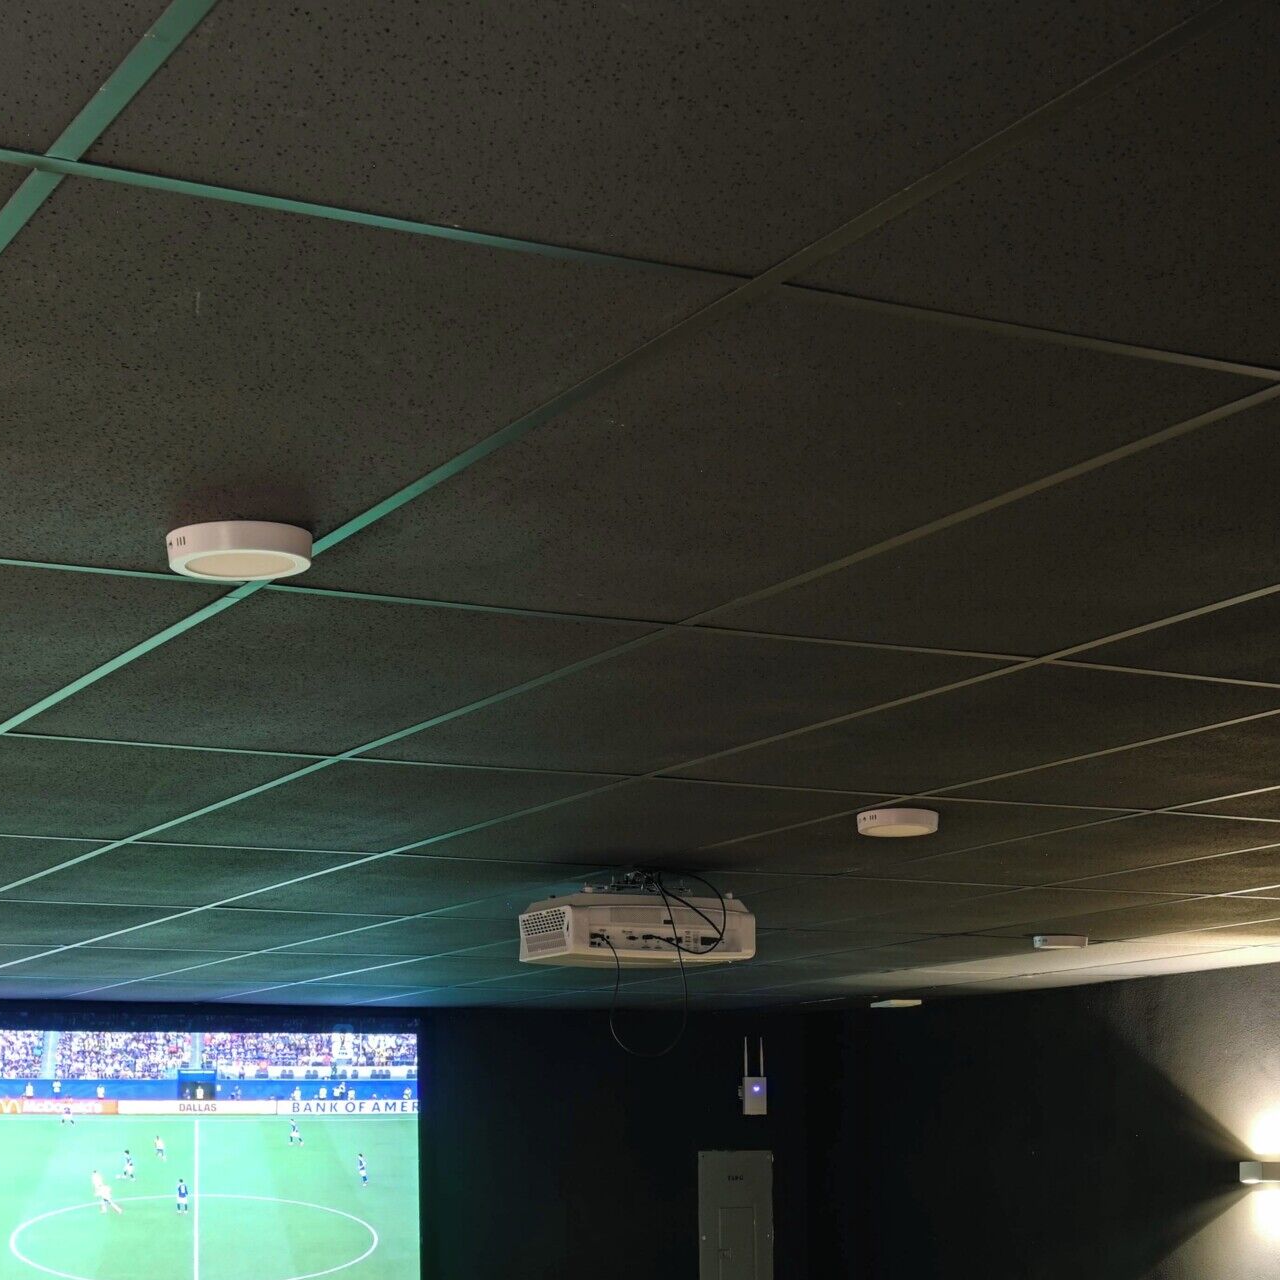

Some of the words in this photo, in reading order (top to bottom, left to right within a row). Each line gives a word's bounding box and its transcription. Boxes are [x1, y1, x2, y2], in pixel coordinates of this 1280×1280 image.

[179, 1103, 217, 1112] DALLAS
[292, 1101, 339, 1113] BANK
[345, 1101, 366, 1113] OF
[371, 1101, 418, 1113] AMER
